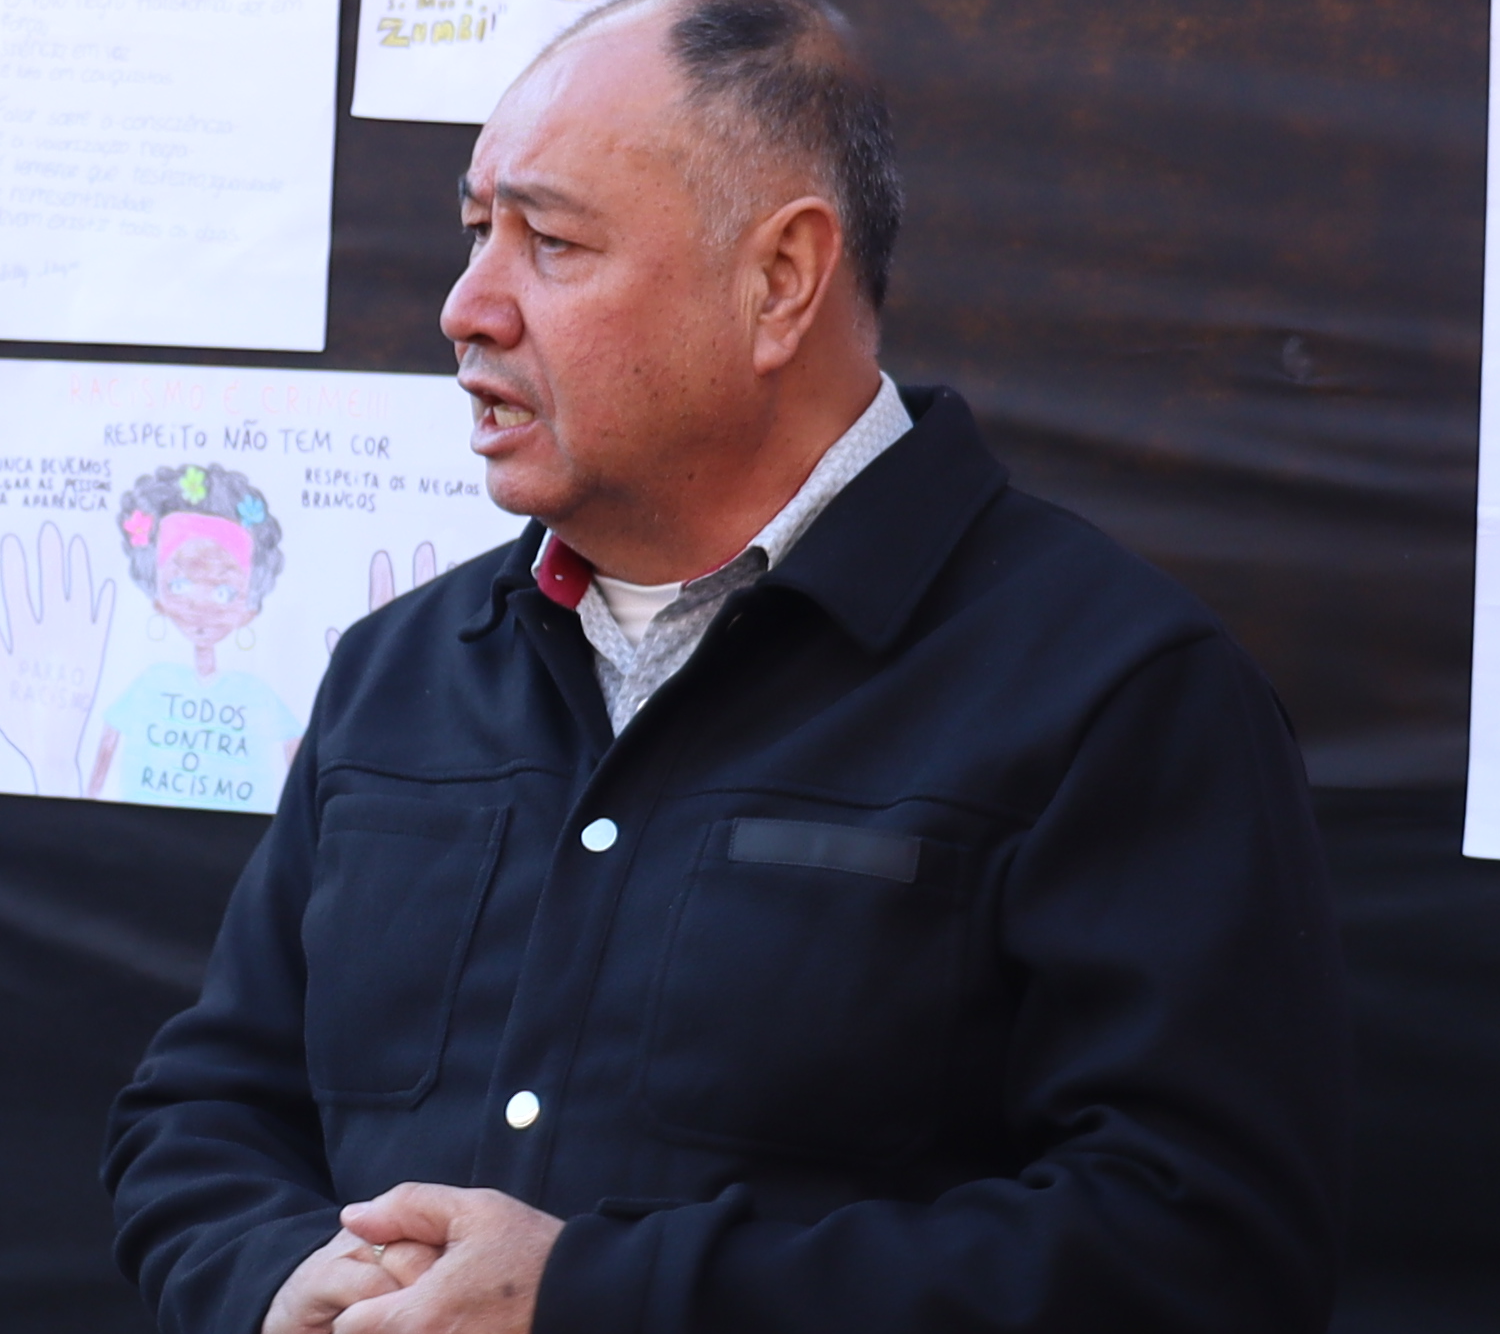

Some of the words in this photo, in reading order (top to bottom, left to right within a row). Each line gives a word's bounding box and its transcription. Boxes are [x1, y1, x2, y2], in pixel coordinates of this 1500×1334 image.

[223, 419, 268, 452] NÃO
[279, 427, 332, 454] TEM
[350, 434, 391, 459] COR
[161, 691, 248, 732] TODOS
[146, 722, 249, 757] CONTRA
[181, 751, 200, 773] O
